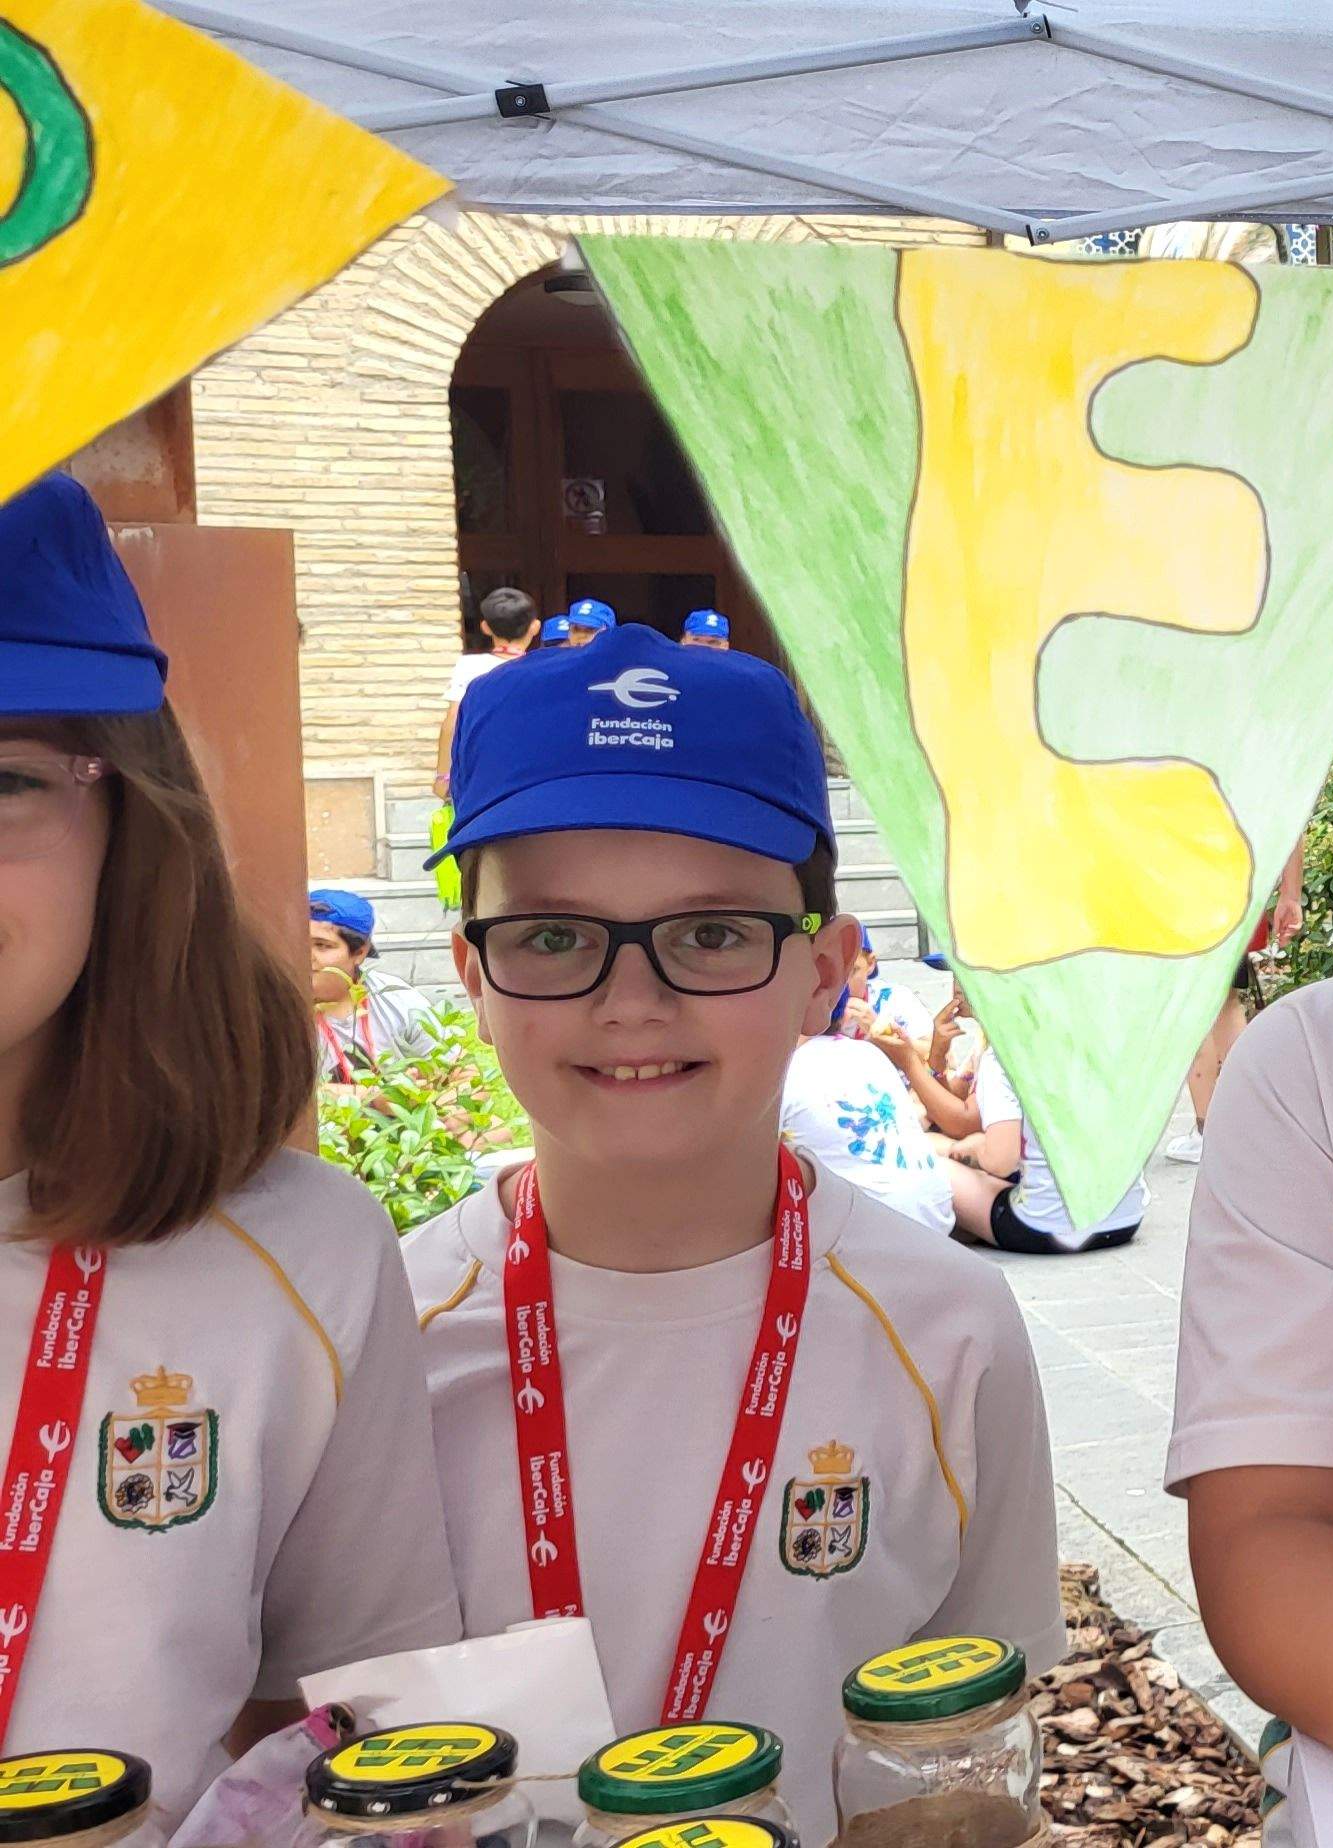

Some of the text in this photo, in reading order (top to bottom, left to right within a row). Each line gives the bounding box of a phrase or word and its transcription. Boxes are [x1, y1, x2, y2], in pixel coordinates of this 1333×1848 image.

[894, 246, 1271, 974] E
[588, 731, 674, 750] iberCaja
[591, 717, 672, 732] Fundación
[791, 1211, 804, 1271] iberCaja
[37, 1291, 67, 1369] Fundación
[57, 1289, 92, 1370] iberCaja
[516, 1305, 536, 1374] iberCaja
[535, 1301, 552, 1366] Fundación
[745, 1352, 770, 1416] Fundación
[760, 1351, 788, 1417] iberCaja
[0, 1472, 30, 1550] Fundación
[18, 1469, 56, 1552] iberCaja
[529, 1455, 550, 1526] iberCaja
[549, 1451, 568, 1518] Fundación
[706, 1500, 734, 1565] Fundación
[722, 1498, 753, 1567] iberCaja
[667, 1652, 694, 1719] Fundación
[682, 1650, 713, 1719] iberCaja
